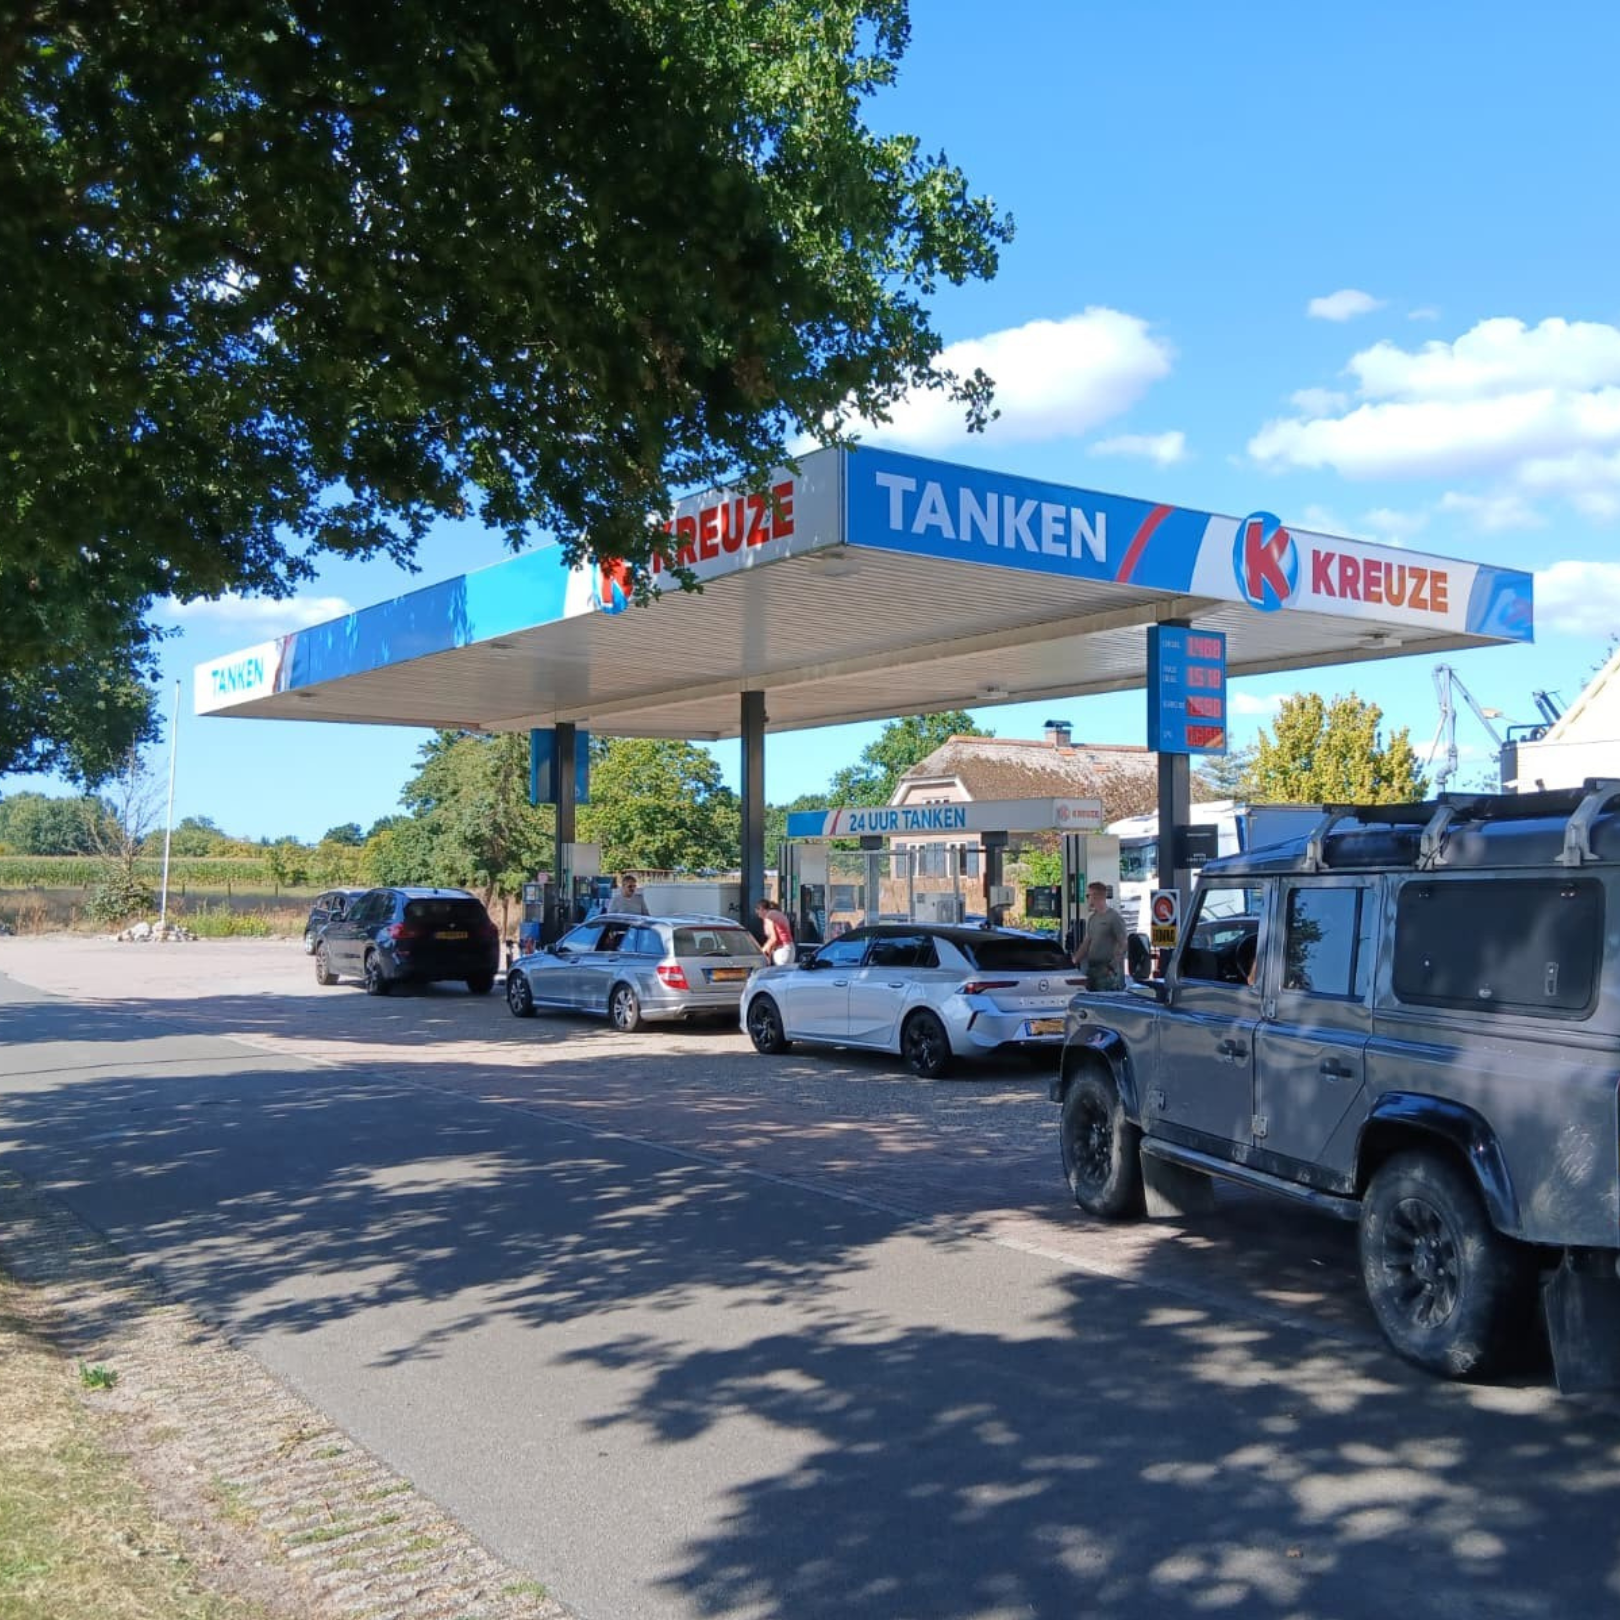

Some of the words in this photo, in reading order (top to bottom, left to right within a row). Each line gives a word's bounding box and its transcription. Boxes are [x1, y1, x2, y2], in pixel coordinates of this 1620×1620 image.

[875, 470, 1107, 563] TANKEN
[1311, 549, 1449, 614] KREUZE
[210, 657, 264, 699] TANKEN
[849, 813, 865, 832] 24
[868, 810, 899, 831] UUR
[902, 807, 966, 830] TANKEN
